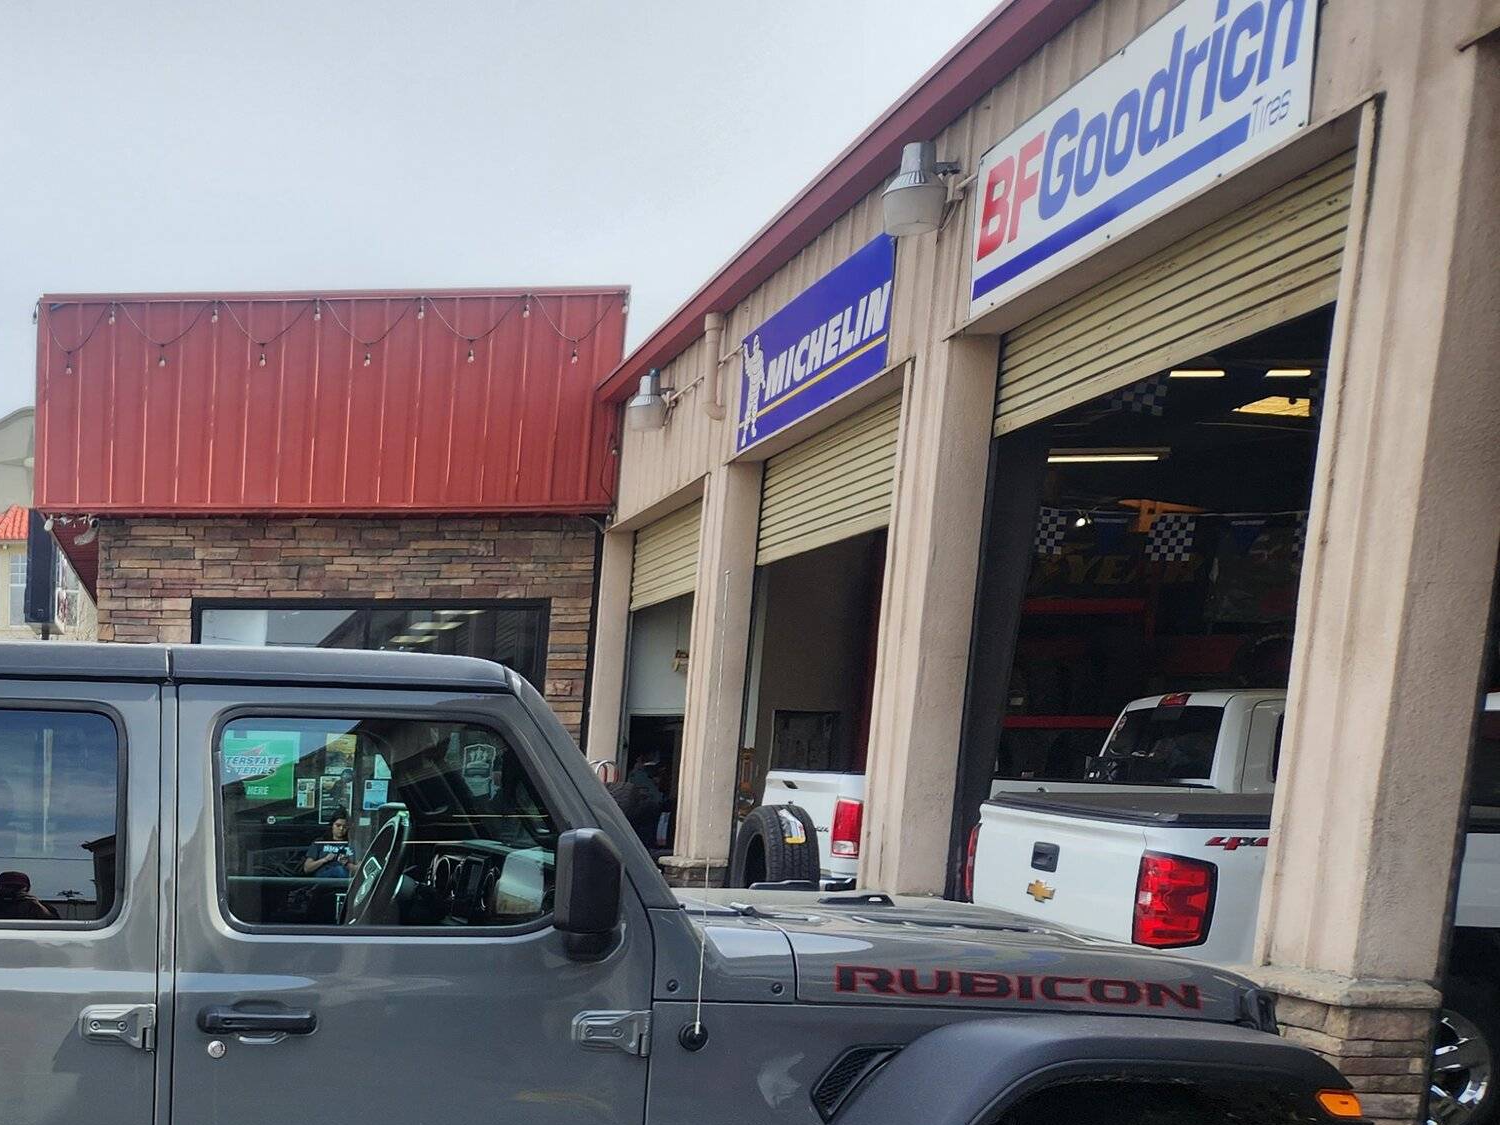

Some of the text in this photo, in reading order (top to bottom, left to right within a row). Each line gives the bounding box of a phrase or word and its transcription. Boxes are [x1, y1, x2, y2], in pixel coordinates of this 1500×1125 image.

[976, 0, 1308, 263] BFGoodrich
[1251, 89, 1292, 138] Tires
[764, 280, 891, 402] MICHELIN
[834, 964, 1202, 1010] RUBICON
